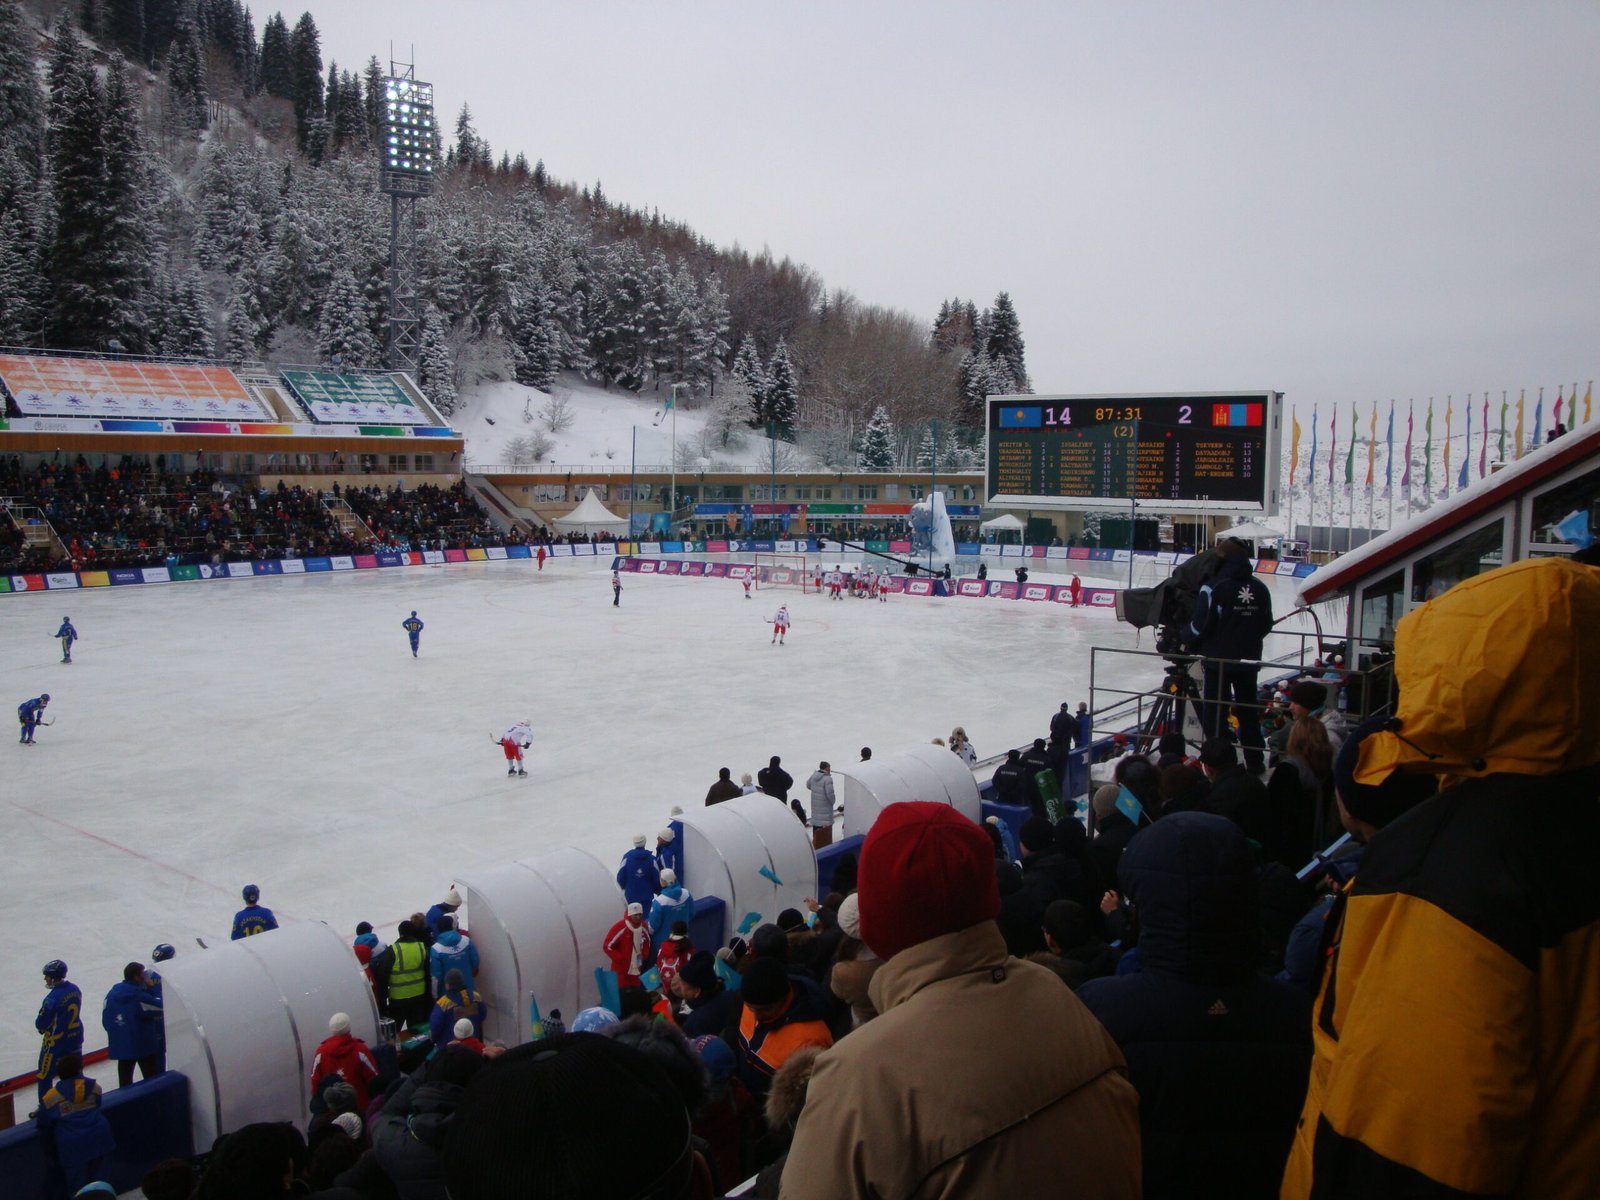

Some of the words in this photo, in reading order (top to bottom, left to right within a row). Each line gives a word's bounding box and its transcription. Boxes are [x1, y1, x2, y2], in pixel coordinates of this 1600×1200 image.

[1045, 407, 1072, 425] 14
[1095, 408, 1142, 421] 87:31
[1178, 405, 1192, 424] 2
[1113, 426, 1134, 438] (2)
[67, 1003, 80, 1030] 2
